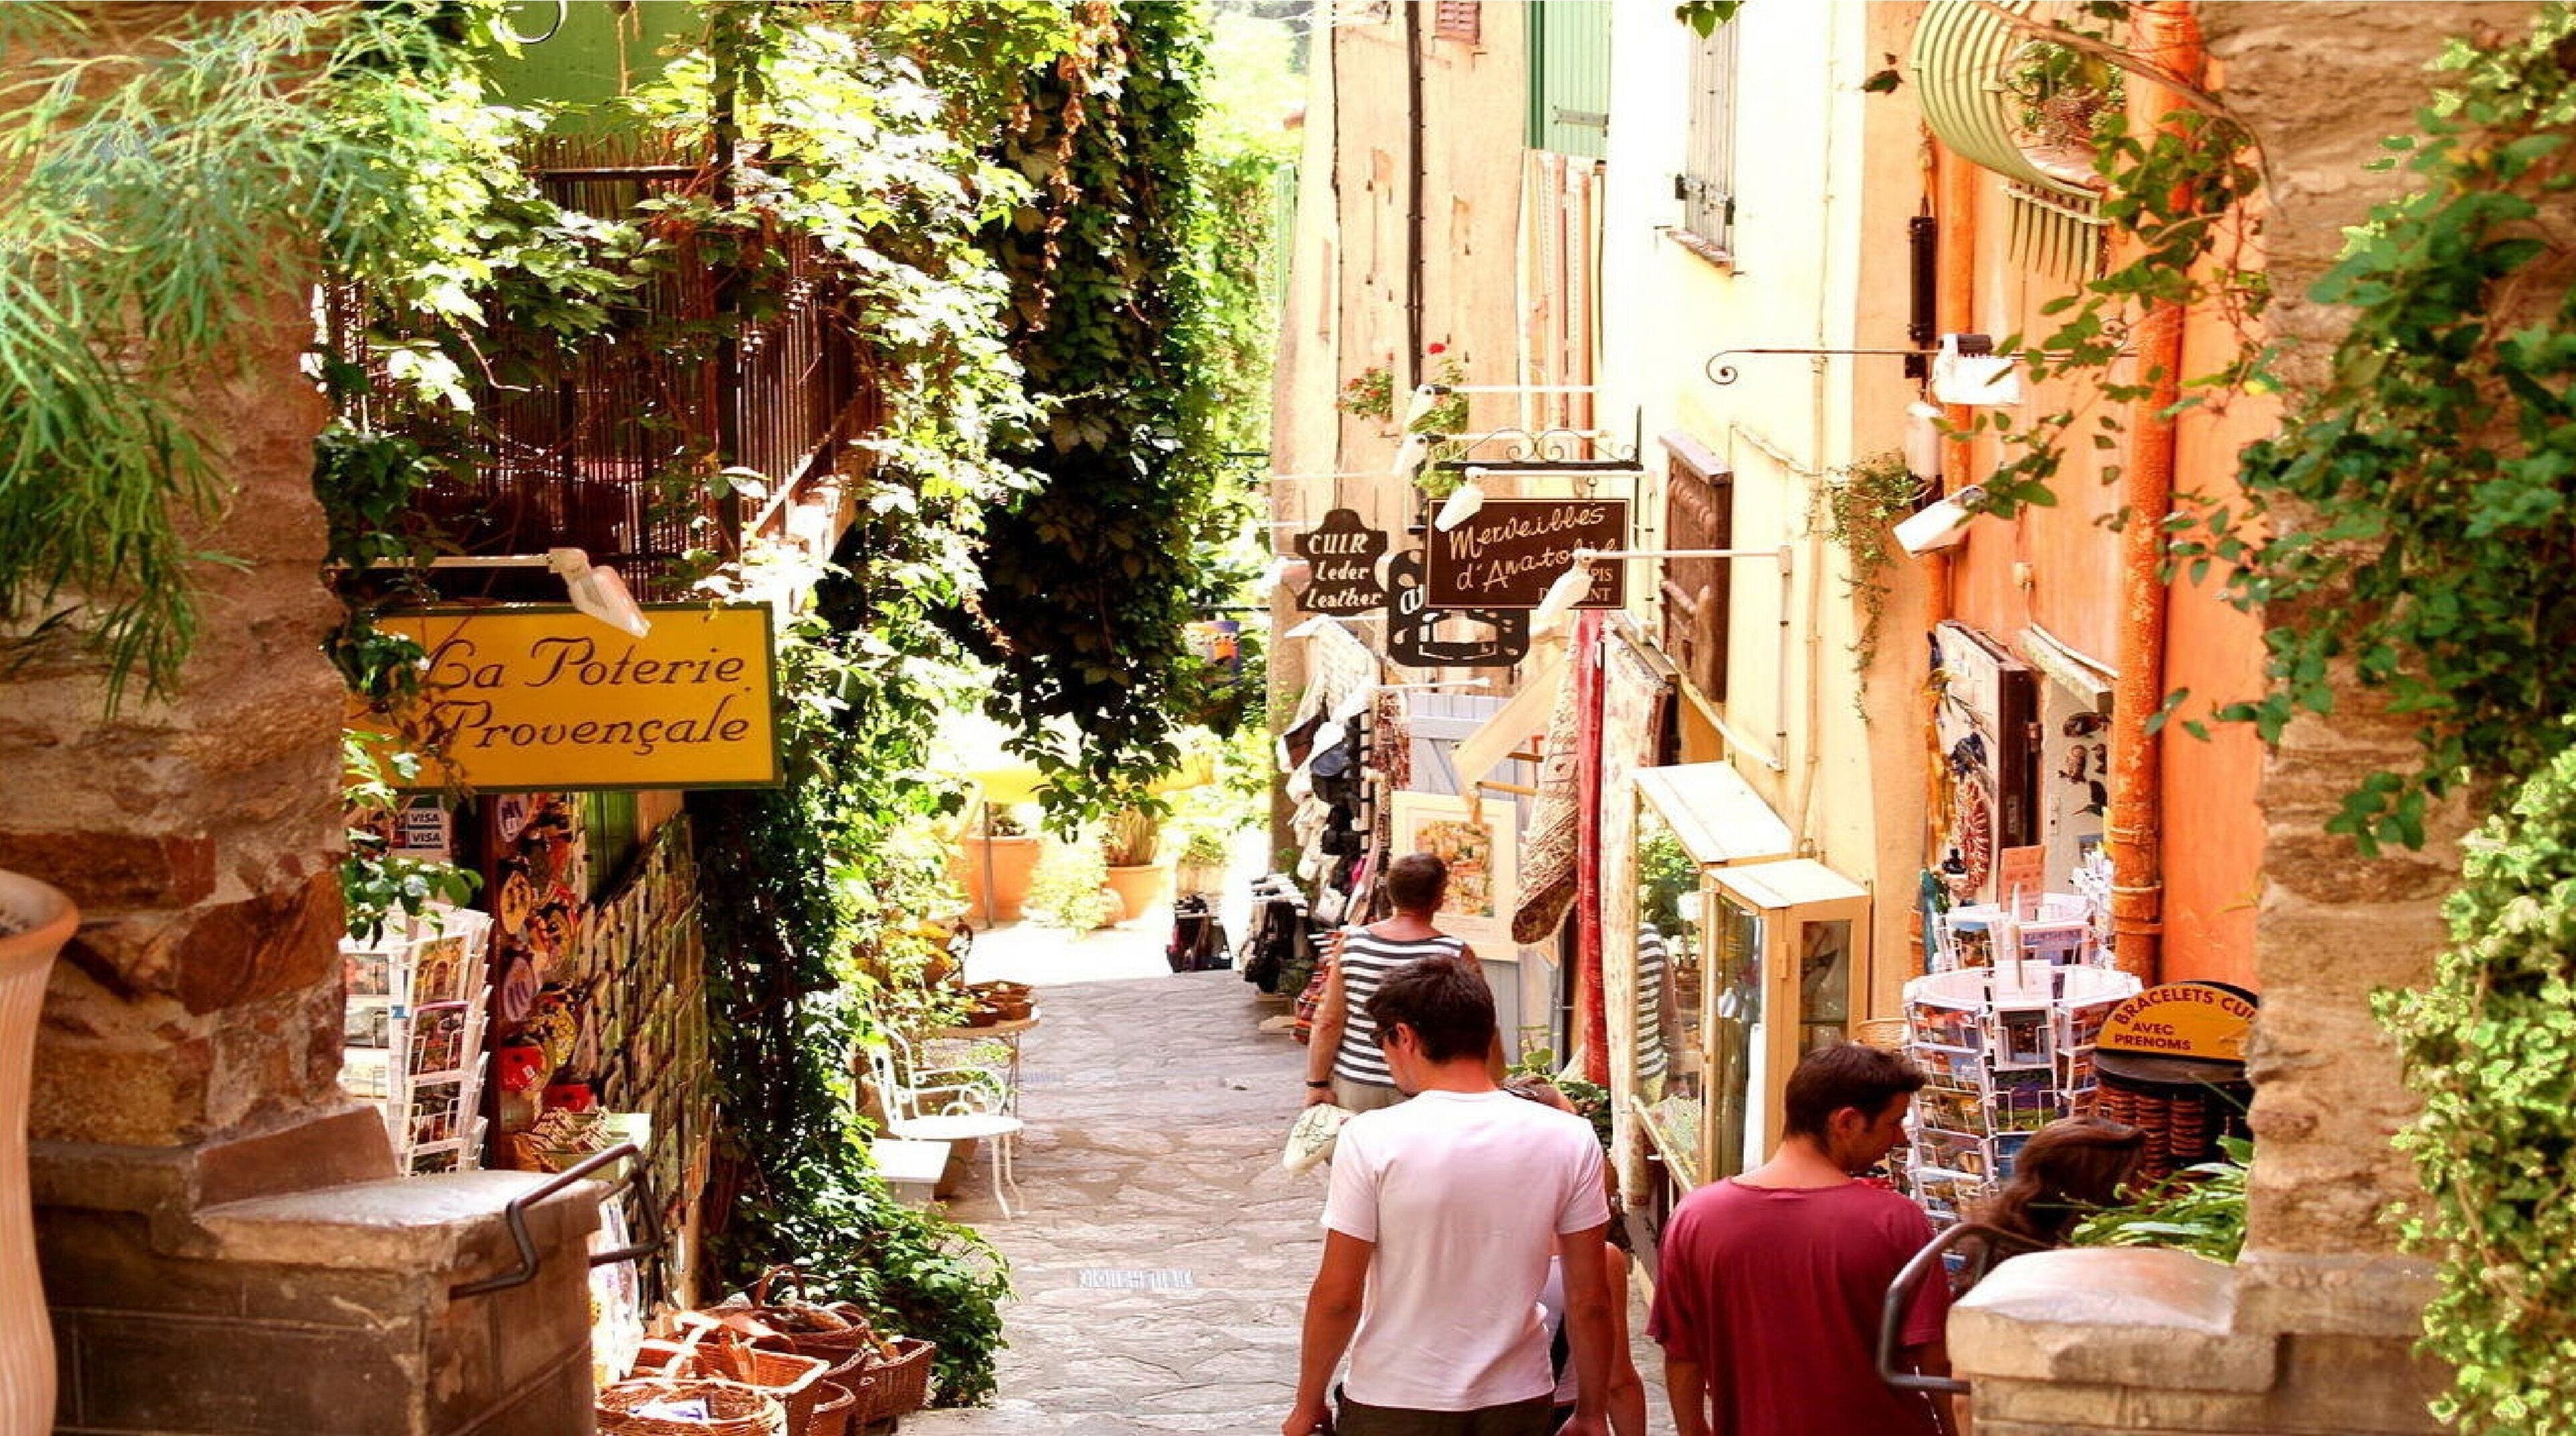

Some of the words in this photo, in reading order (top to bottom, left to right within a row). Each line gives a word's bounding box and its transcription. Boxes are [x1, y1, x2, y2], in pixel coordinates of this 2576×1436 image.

[1448, 505, 1606, 560] Merveilles
[1307, 533, 1368, 554] CUIR
[1315, 560, 1371, 581] Leder
[1456, 537, 1617, 593] d'Anatoe
[1305, 587, 1383, 608] Leather
[421, 639, 504, 688] La
[524, 635, 745, 688] Poterie
[419, 693, 750, 756] Provençale
[411, 813, 440, 822] VISA
[413, 832, 441, 842] VISA
[2114, 987, 2215, 1025] BRACELETS
[2220, 997, 2256, 1021] CUI
[2131, 1023, 2175, 1036] AVEC
[2114, 1034, 2192, 1050] PRENOMS
